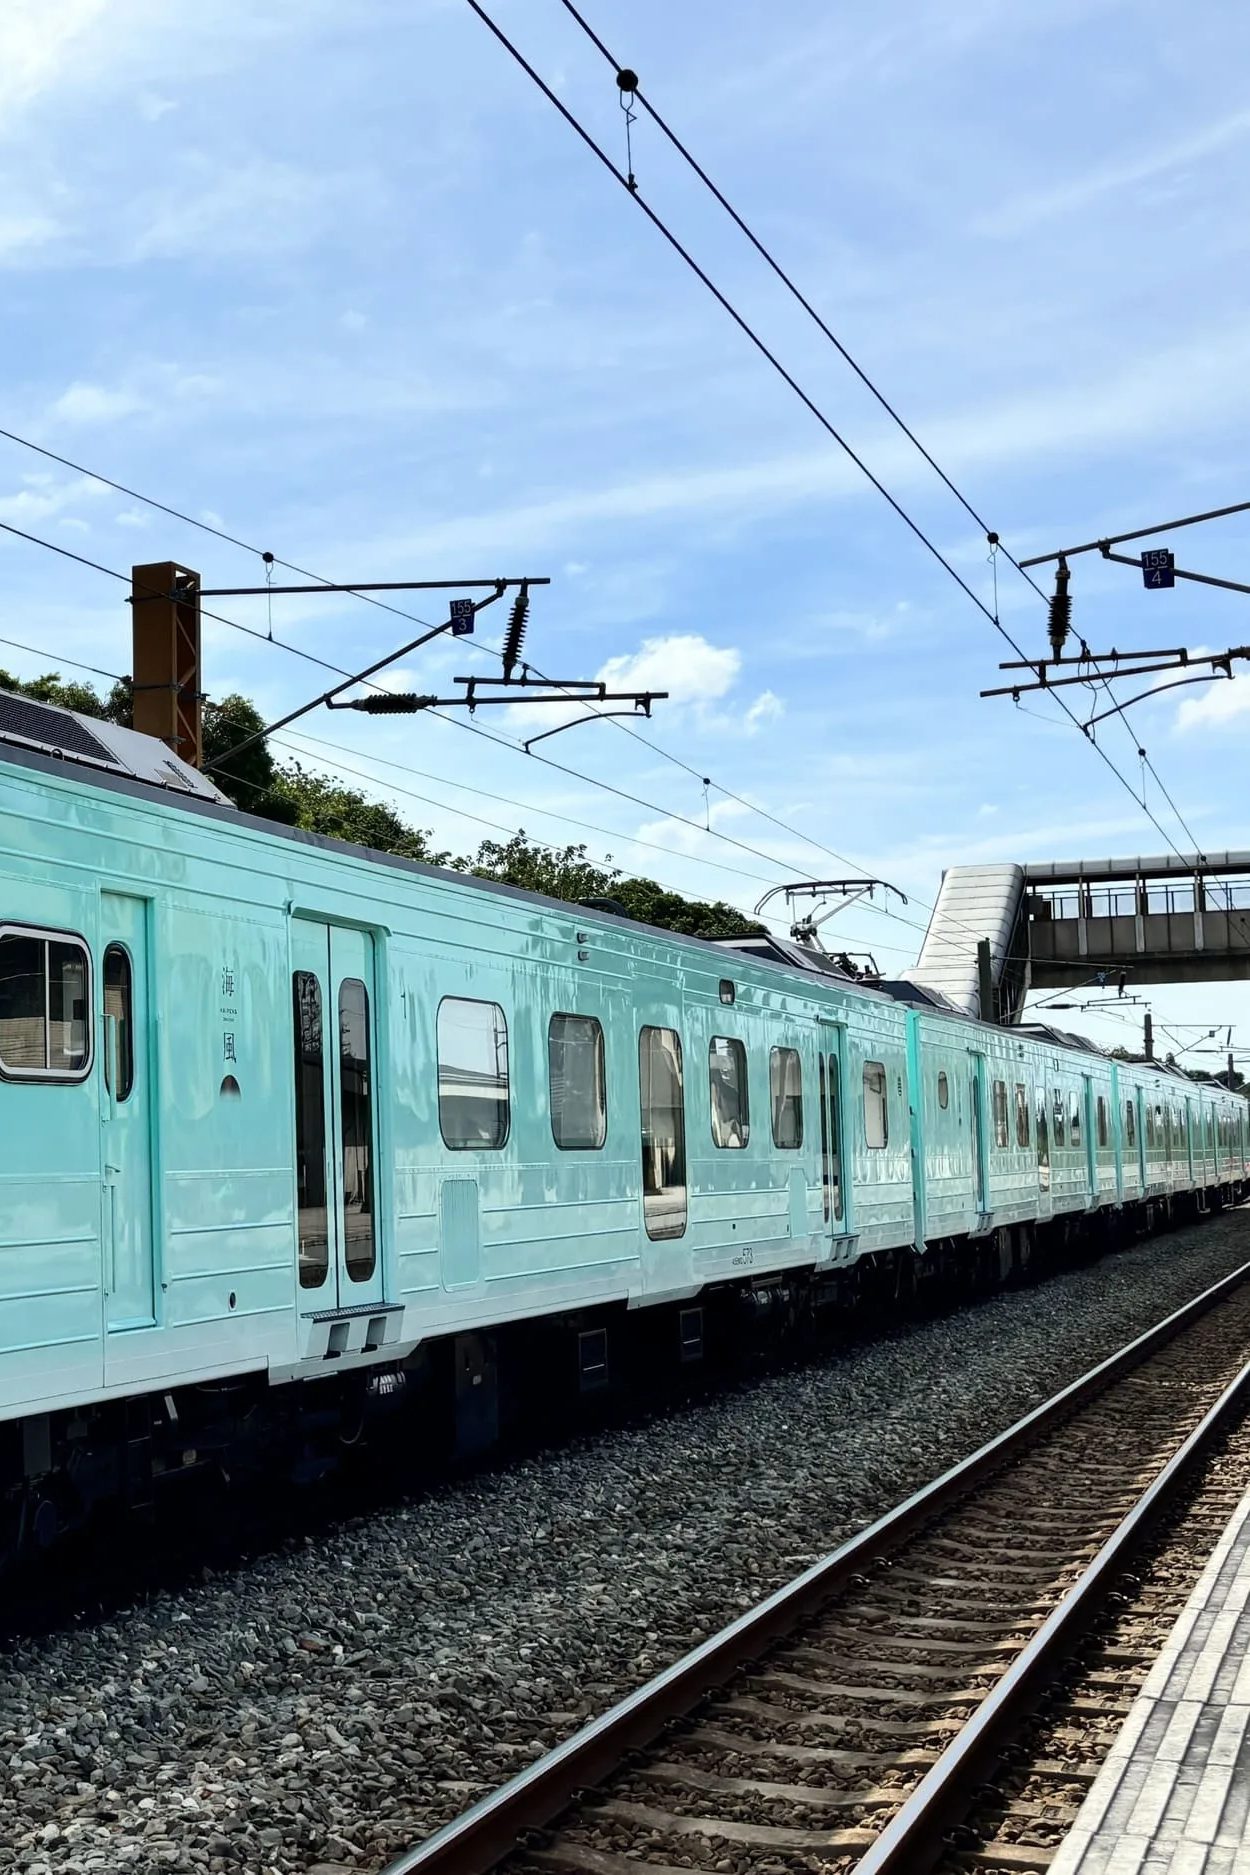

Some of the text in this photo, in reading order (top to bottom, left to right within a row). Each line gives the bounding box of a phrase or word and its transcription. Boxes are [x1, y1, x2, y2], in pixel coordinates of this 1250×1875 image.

[1145, 551, 1167, 567] 155
[1152, 570, 1162, 584] 4
[452, 601, 471, 614] 155
[459, 618, 467, 630] 3
